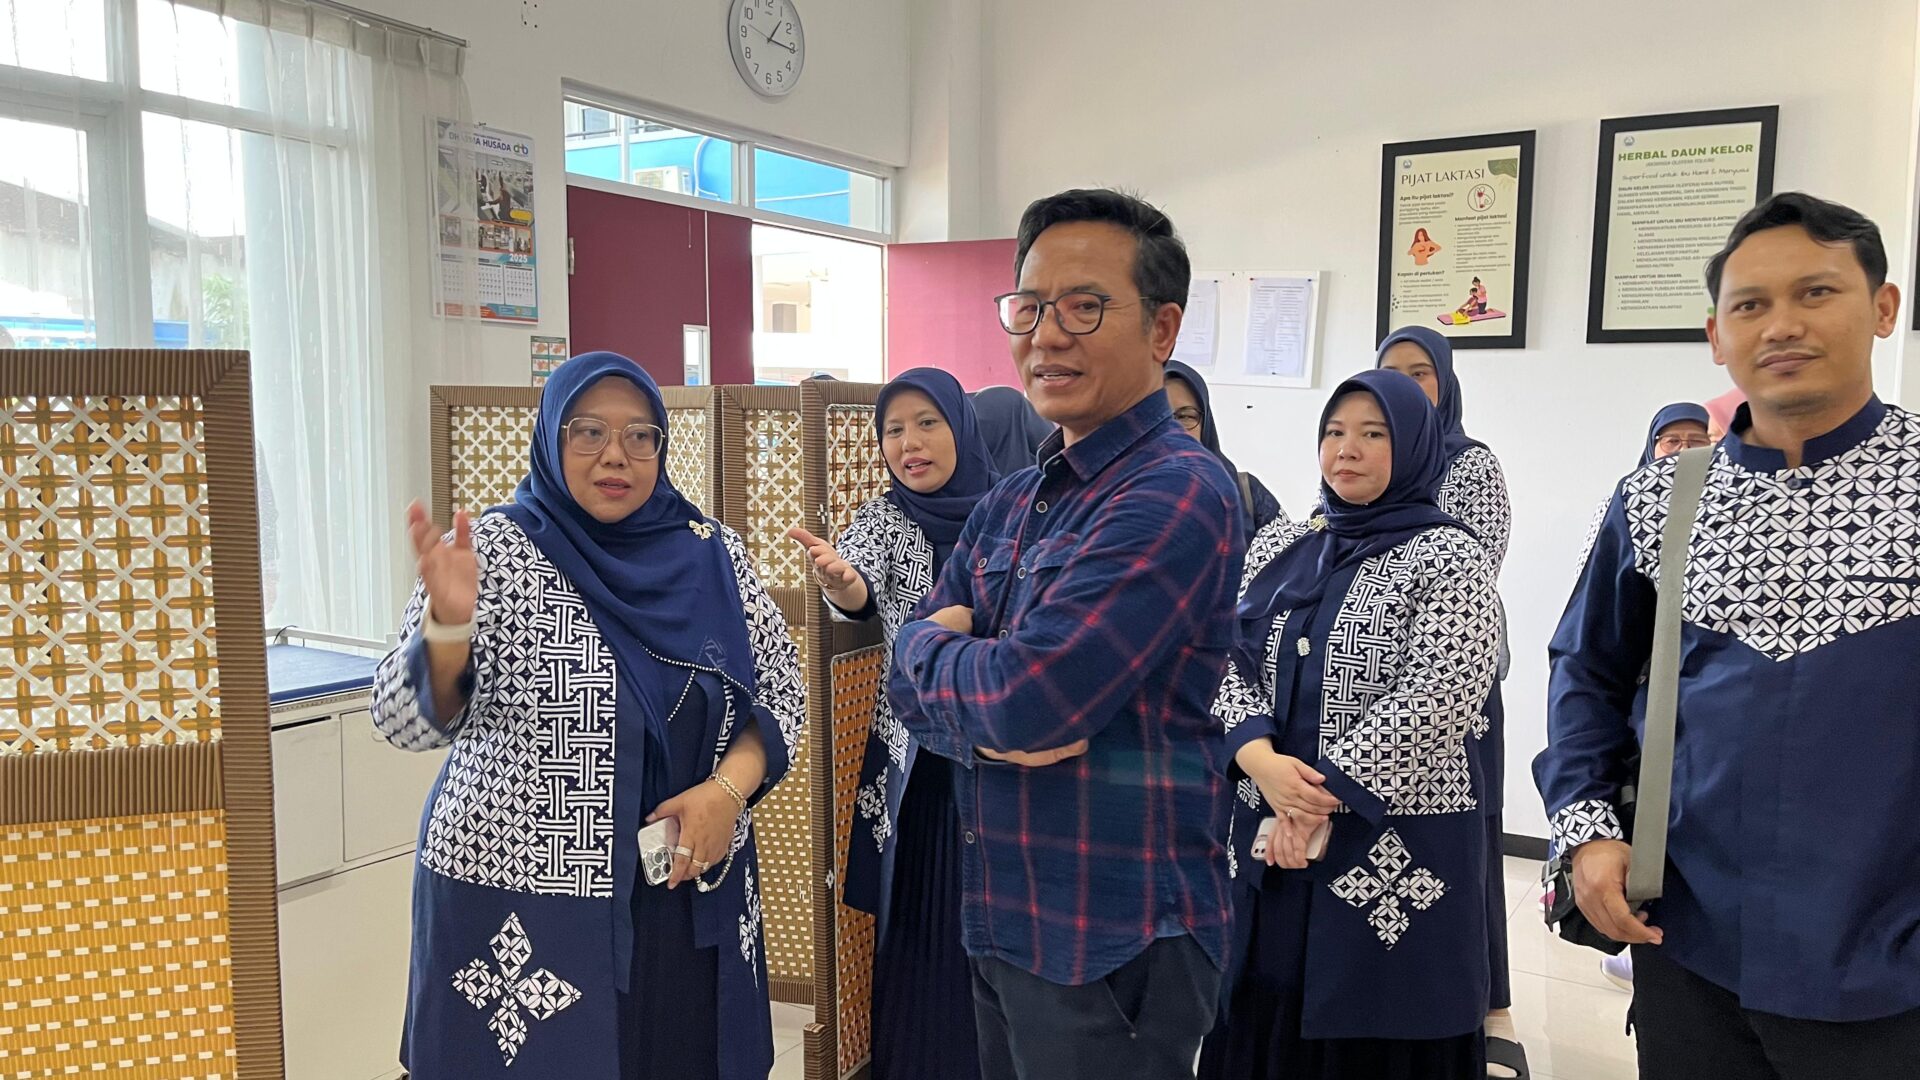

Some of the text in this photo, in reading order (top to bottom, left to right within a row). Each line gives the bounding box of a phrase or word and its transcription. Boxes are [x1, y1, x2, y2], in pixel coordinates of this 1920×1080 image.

[744, 6, 753, 20] 10
[741, 25, 747, 38] 9
[786, 22, 792, 35] 2
[745, 46, 751, 59] 8
[789, 42, 796, 54] 3
[754, 62, 759, 75] 7
[786, 60, 791, 72] 4
[766, 72, 772, 84] 6
[777, 70, 782, 82] 5
[483, 138, 511, 152] HUSADA
[1618, 144, 1753, 161] HERBAL DAUN KELOR
[1401, 169, 1485, 187] PIJAT LAKTASI
[1419, 193, 1432, 201] pijat
[1476, 214, 1489, 222] pijat
[510, 253, 528, 263] 2025
